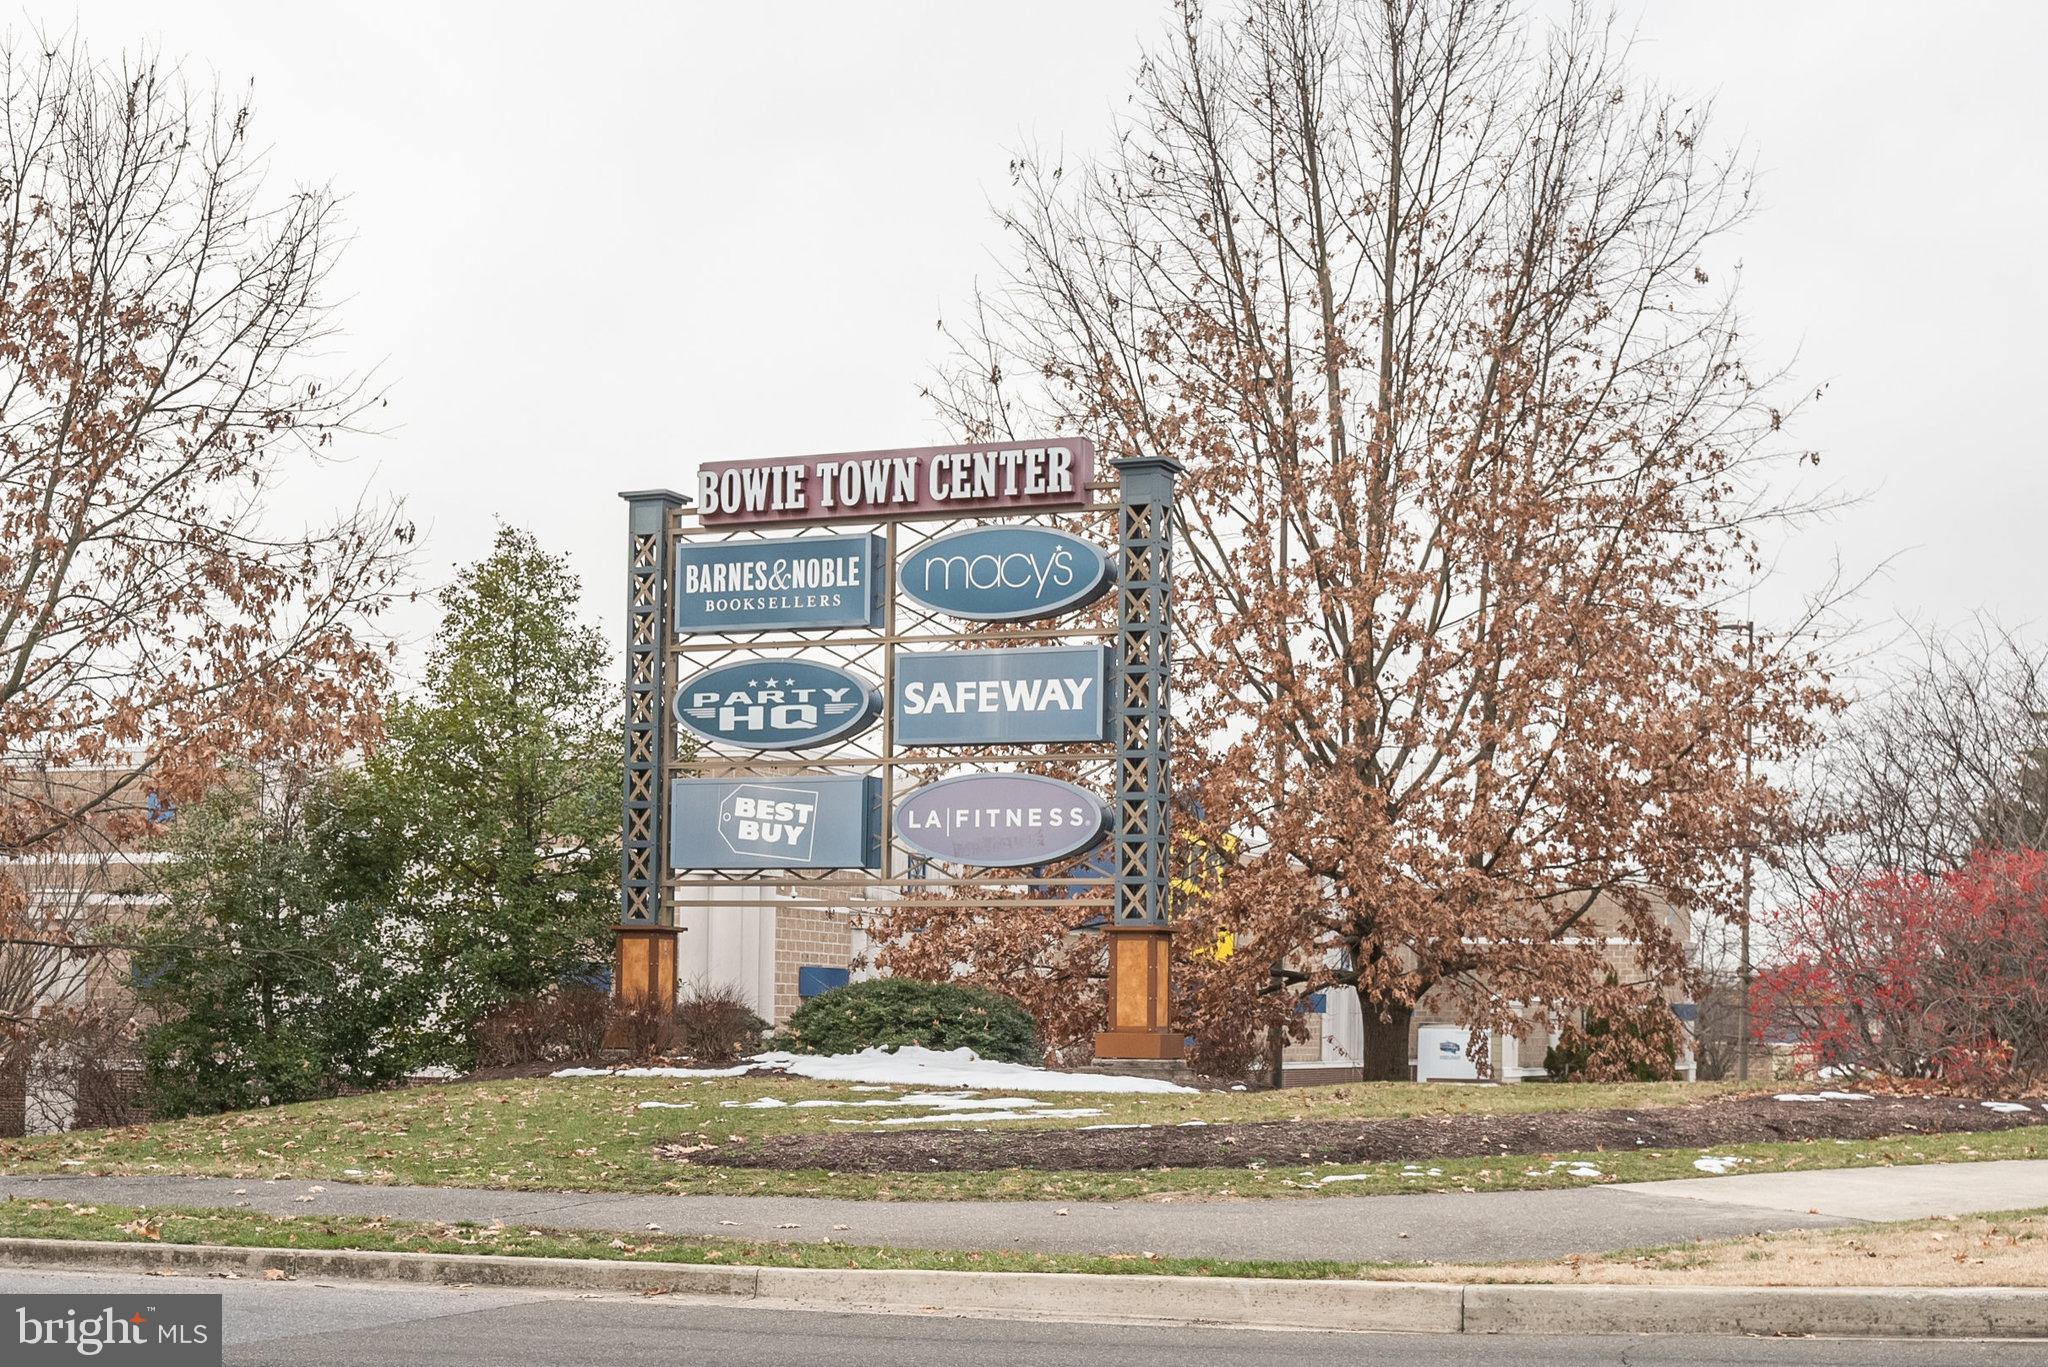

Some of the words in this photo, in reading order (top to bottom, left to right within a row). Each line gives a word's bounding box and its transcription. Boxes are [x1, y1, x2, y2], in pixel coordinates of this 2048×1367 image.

[699, 465, 806, 515] BOWIE
[817, 457, 916, 506] TOWN
[929, 446, 1072, 500] CENTER
[924, 545, 1073, 599] macy's
[704, 594, 842, 612] BOOKSELLERS
[693, 687, 852, 708] PARTY
[903, 677, 1093, 715] SAFEWAY
[718, 706, 818, 731] HQ
[734, 797, 814, 823] BEST
[738, 821, 805, 846] BUY
